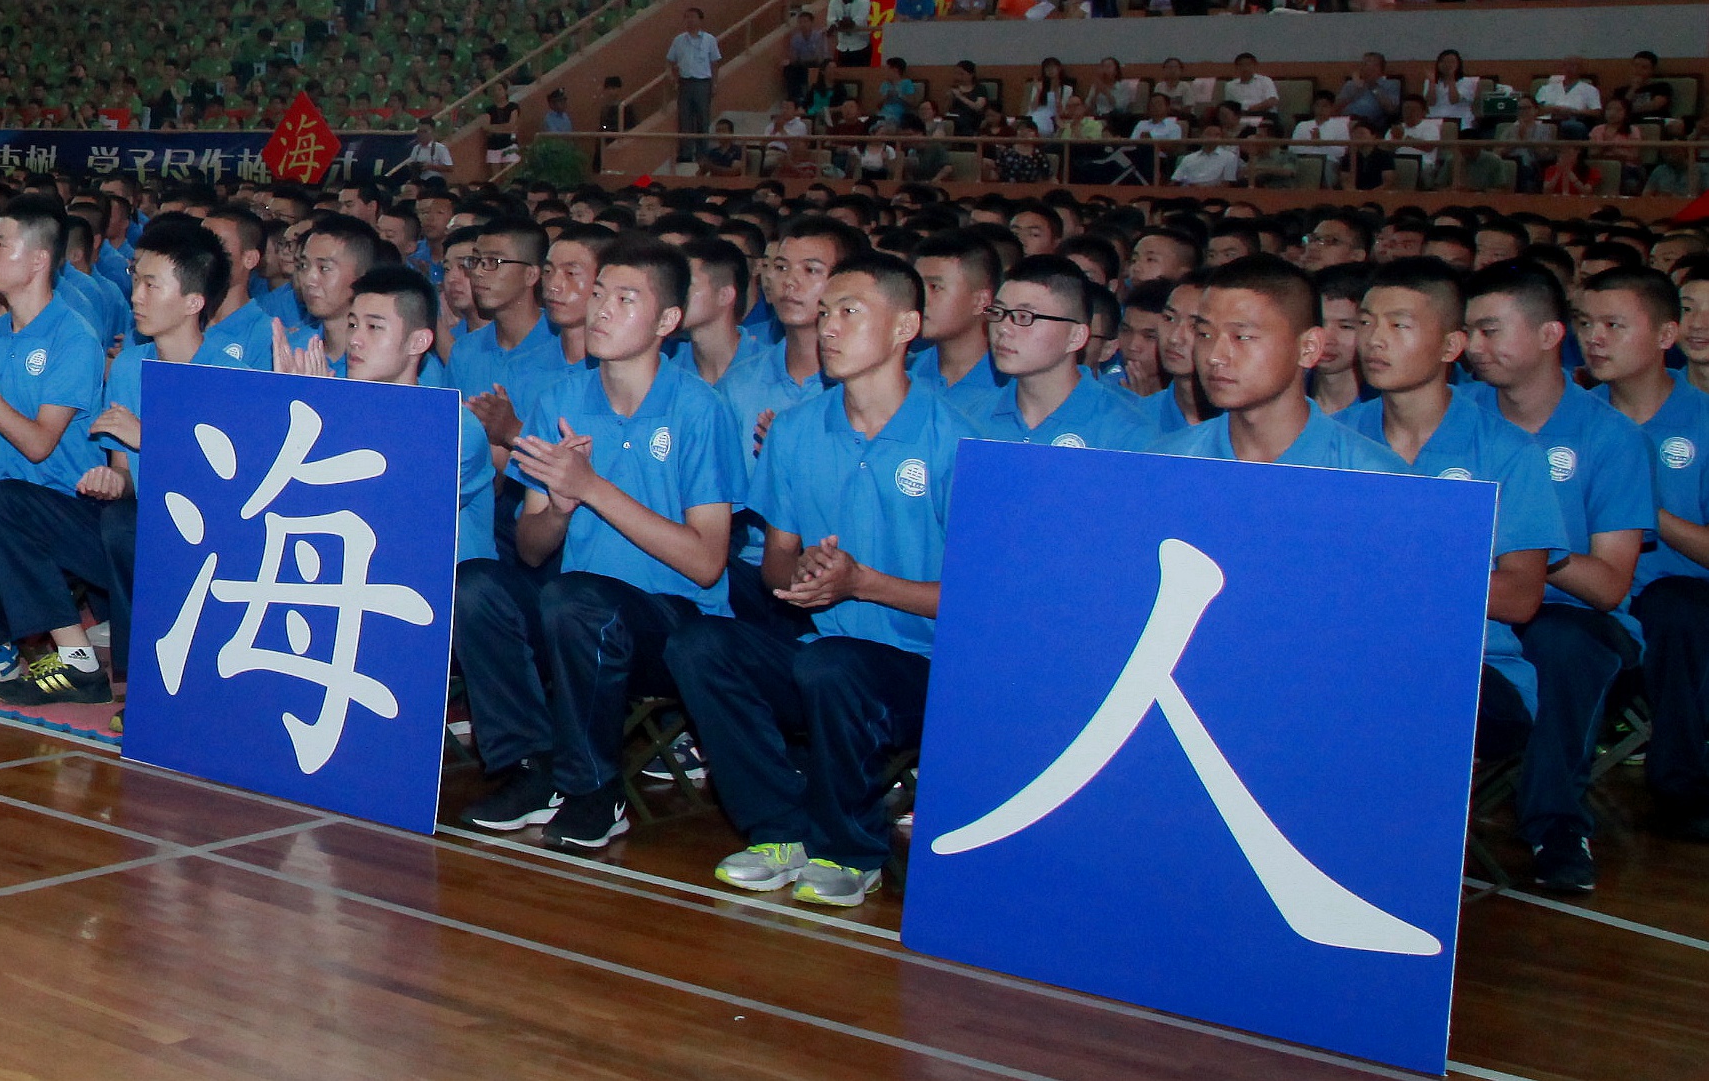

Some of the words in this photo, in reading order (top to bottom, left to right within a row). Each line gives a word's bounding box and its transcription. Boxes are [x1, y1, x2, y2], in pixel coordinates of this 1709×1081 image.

[278, 114, 326, 184] 海
[154, 399, 434, 776] 海
[930, 537, 1443, 957] 人
